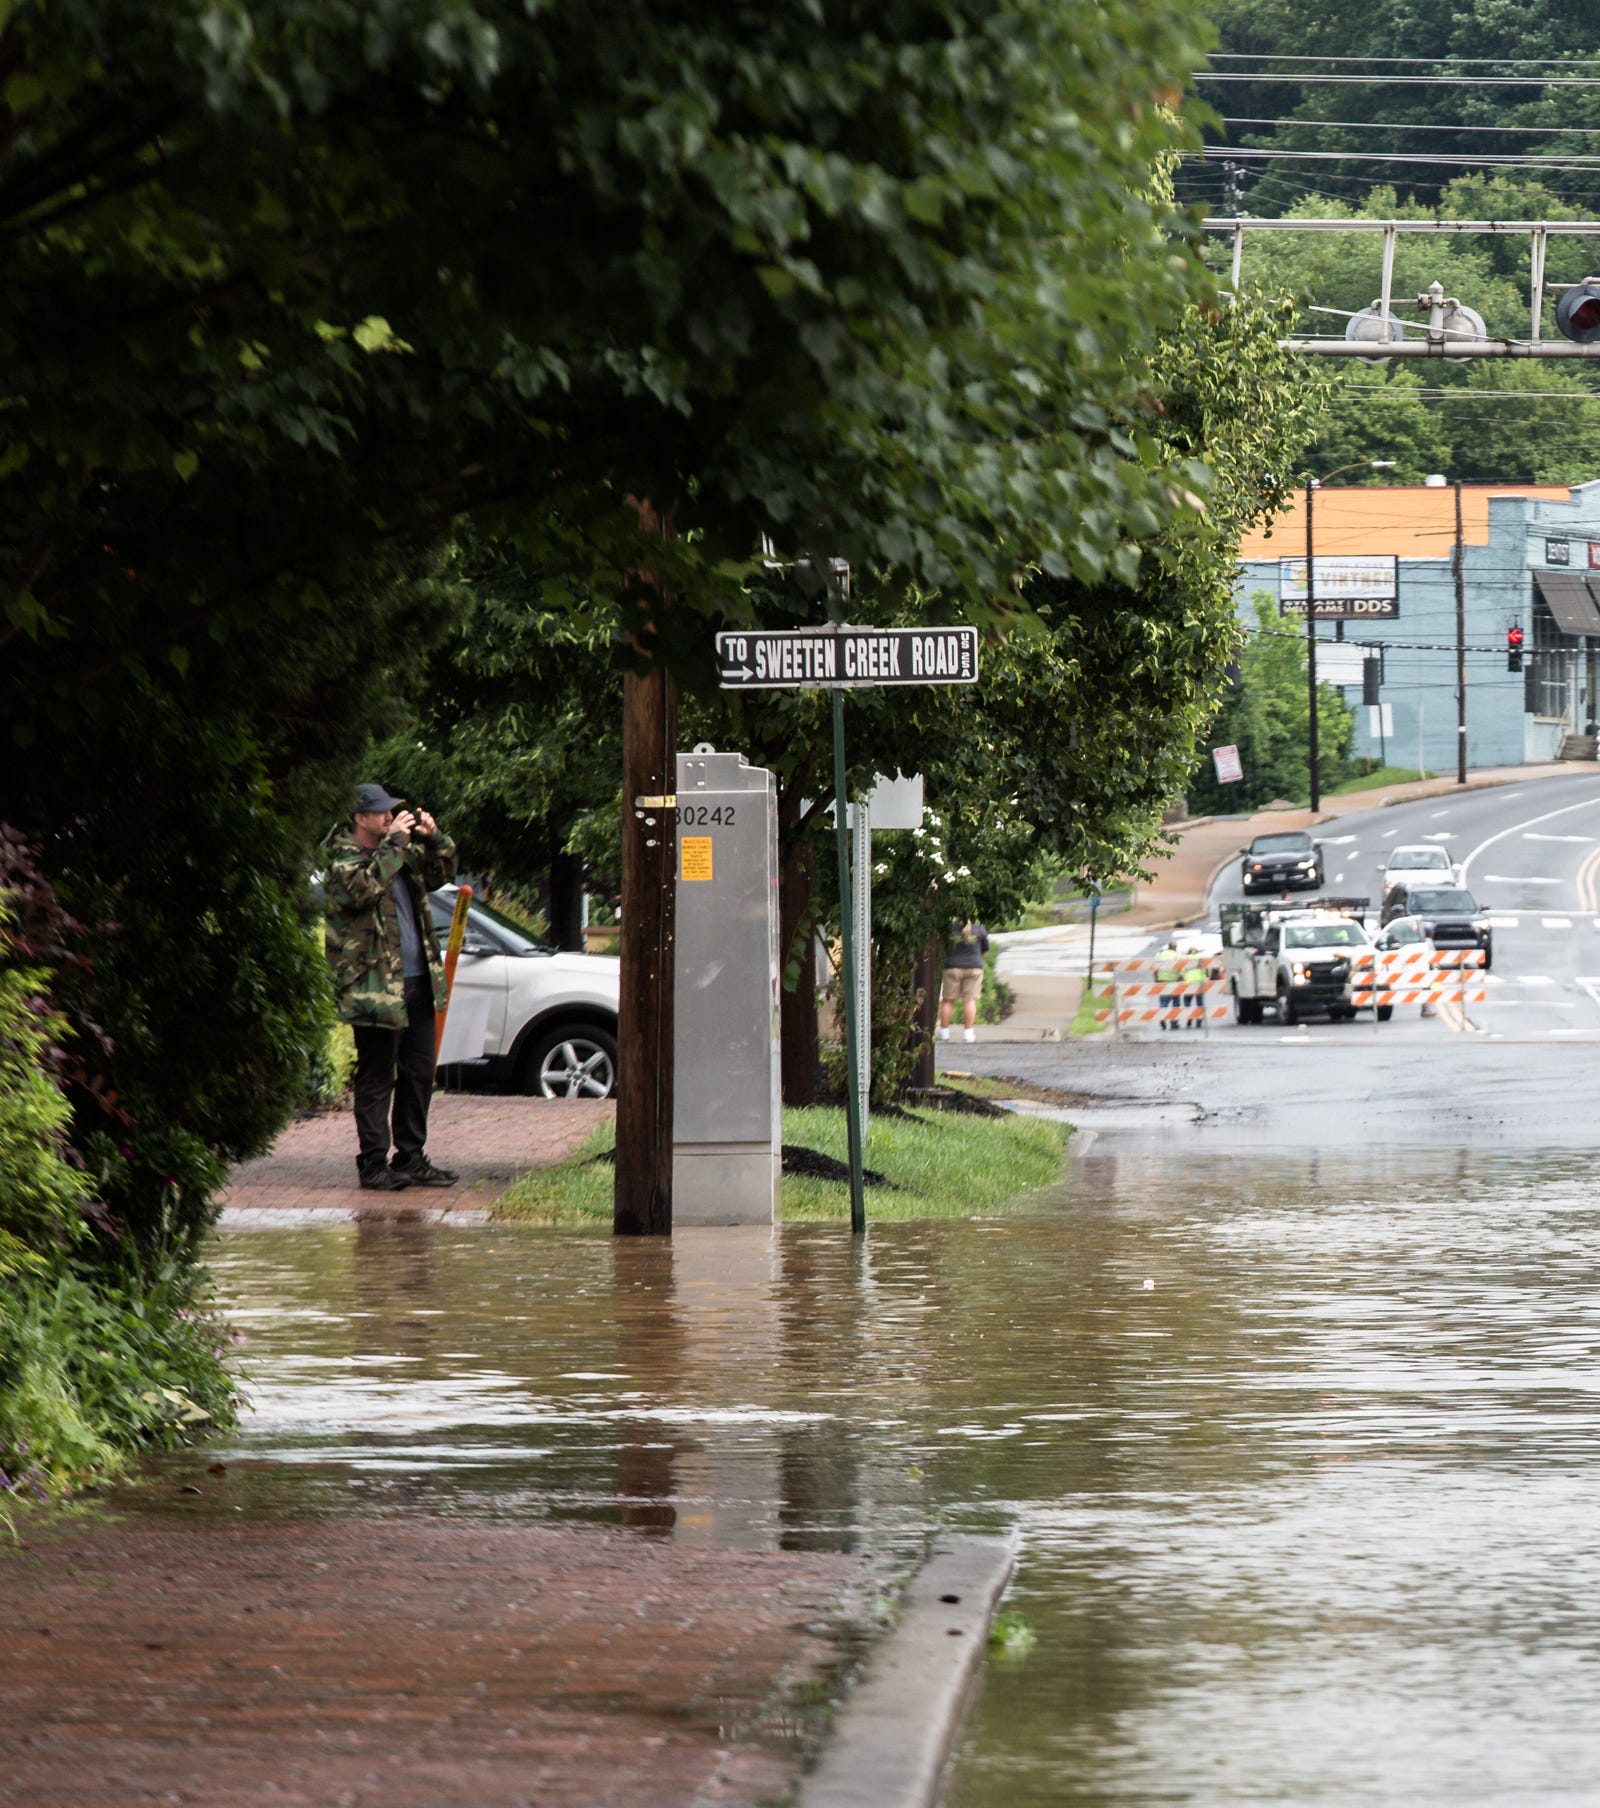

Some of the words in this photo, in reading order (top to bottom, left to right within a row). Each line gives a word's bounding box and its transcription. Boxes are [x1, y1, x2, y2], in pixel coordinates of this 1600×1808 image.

[1354, 600, 1393, 613] DDS
[725, 638, 747, 662] TO
[755, 638, 837, 679] SWEETEN
[844, 637, 900, 677] CREEK
[912, 635, 959, 676] ROAD
